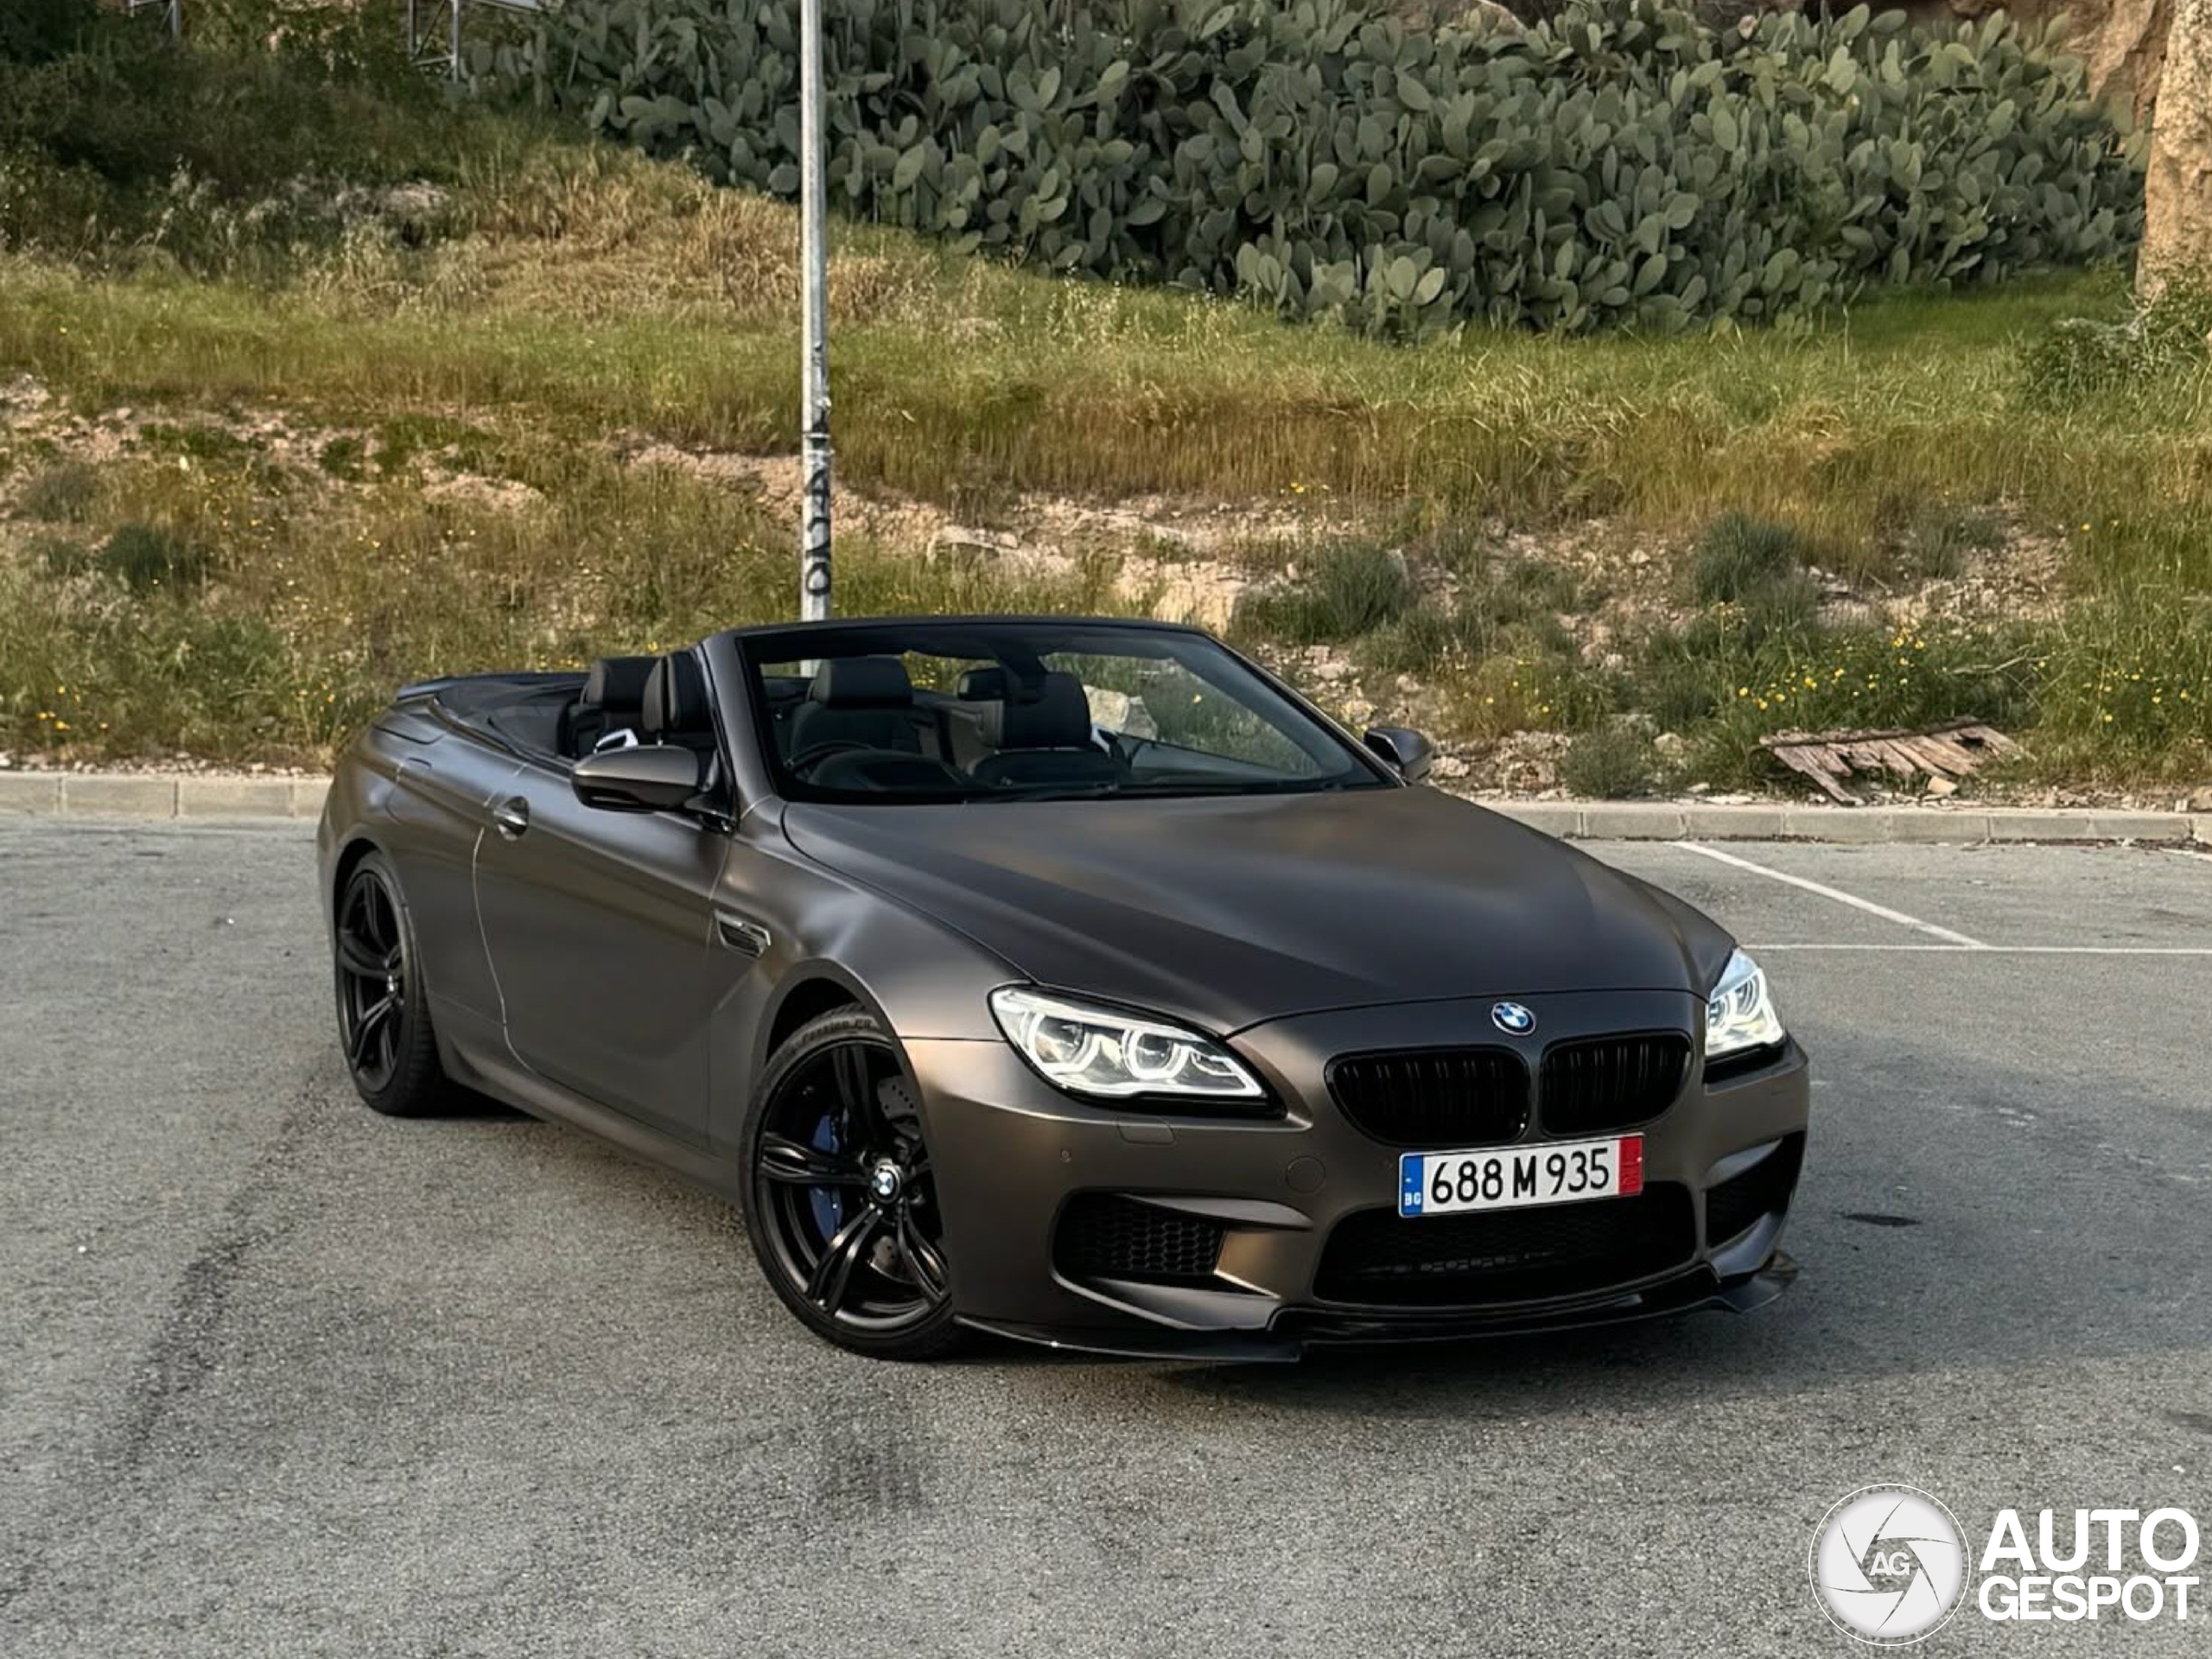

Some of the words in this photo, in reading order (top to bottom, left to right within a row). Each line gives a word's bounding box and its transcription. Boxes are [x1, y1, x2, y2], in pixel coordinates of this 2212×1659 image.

[1431, 1159, 1503, 1204] 688
[1513, 1155, 1536, 1198] M
[1546, 1147, 1610, 1196] 935
[1405, 1192, 1421, 1206] BG
